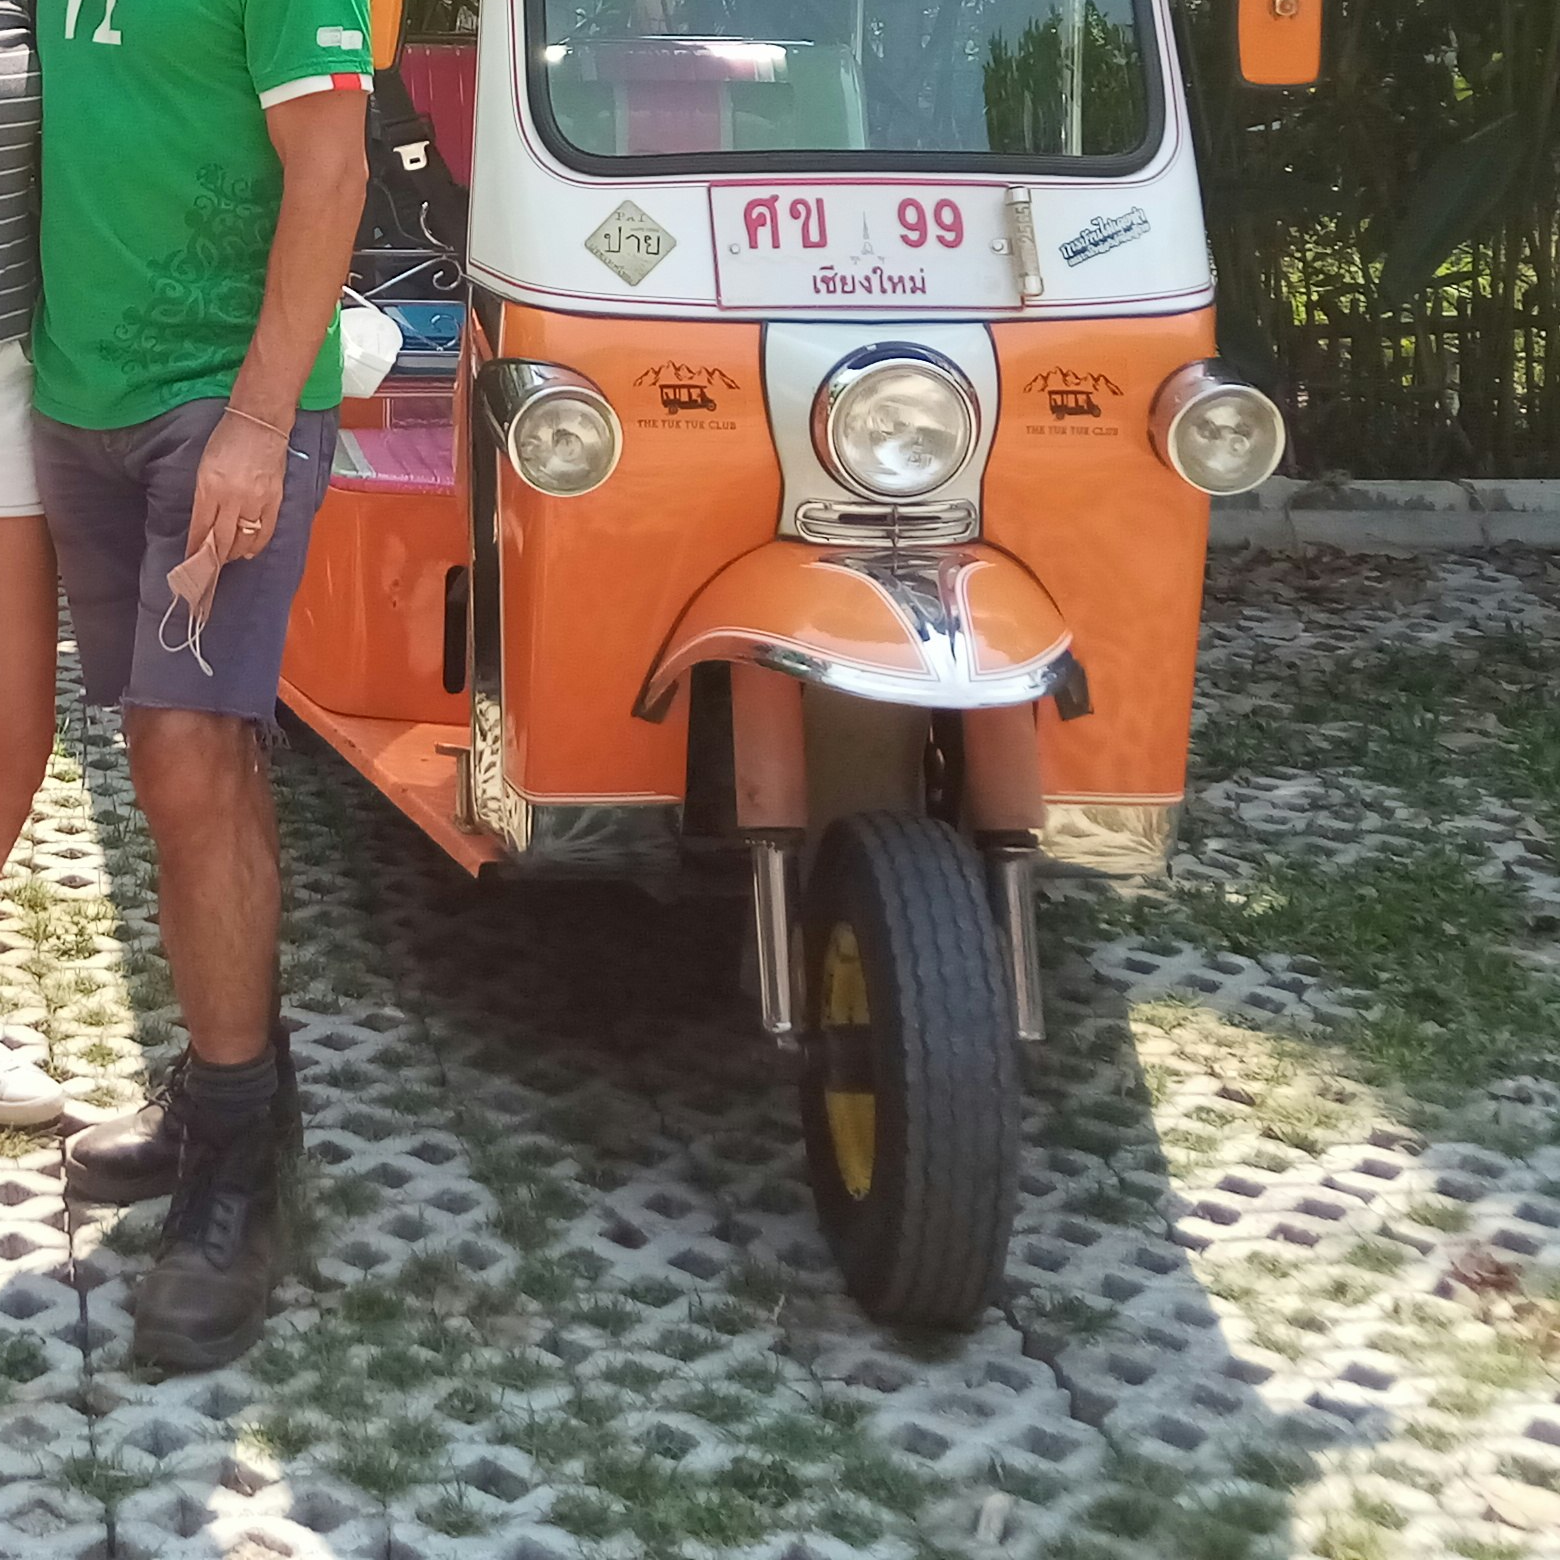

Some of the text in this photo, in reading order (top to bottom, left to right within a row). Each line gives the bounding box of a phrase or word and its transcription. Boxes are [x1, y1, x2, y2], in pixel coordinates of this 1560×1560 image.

[743, 194, 965, 249] ศข 99
[603, 225, 660, 256] ปาย
[812, 264, 927, 295] เชียงใหม่
[637, 419, 737, 430] THE TUK TUK CLUB
[1026, 425, 1119, 437] THE TUK TUK CLUB
